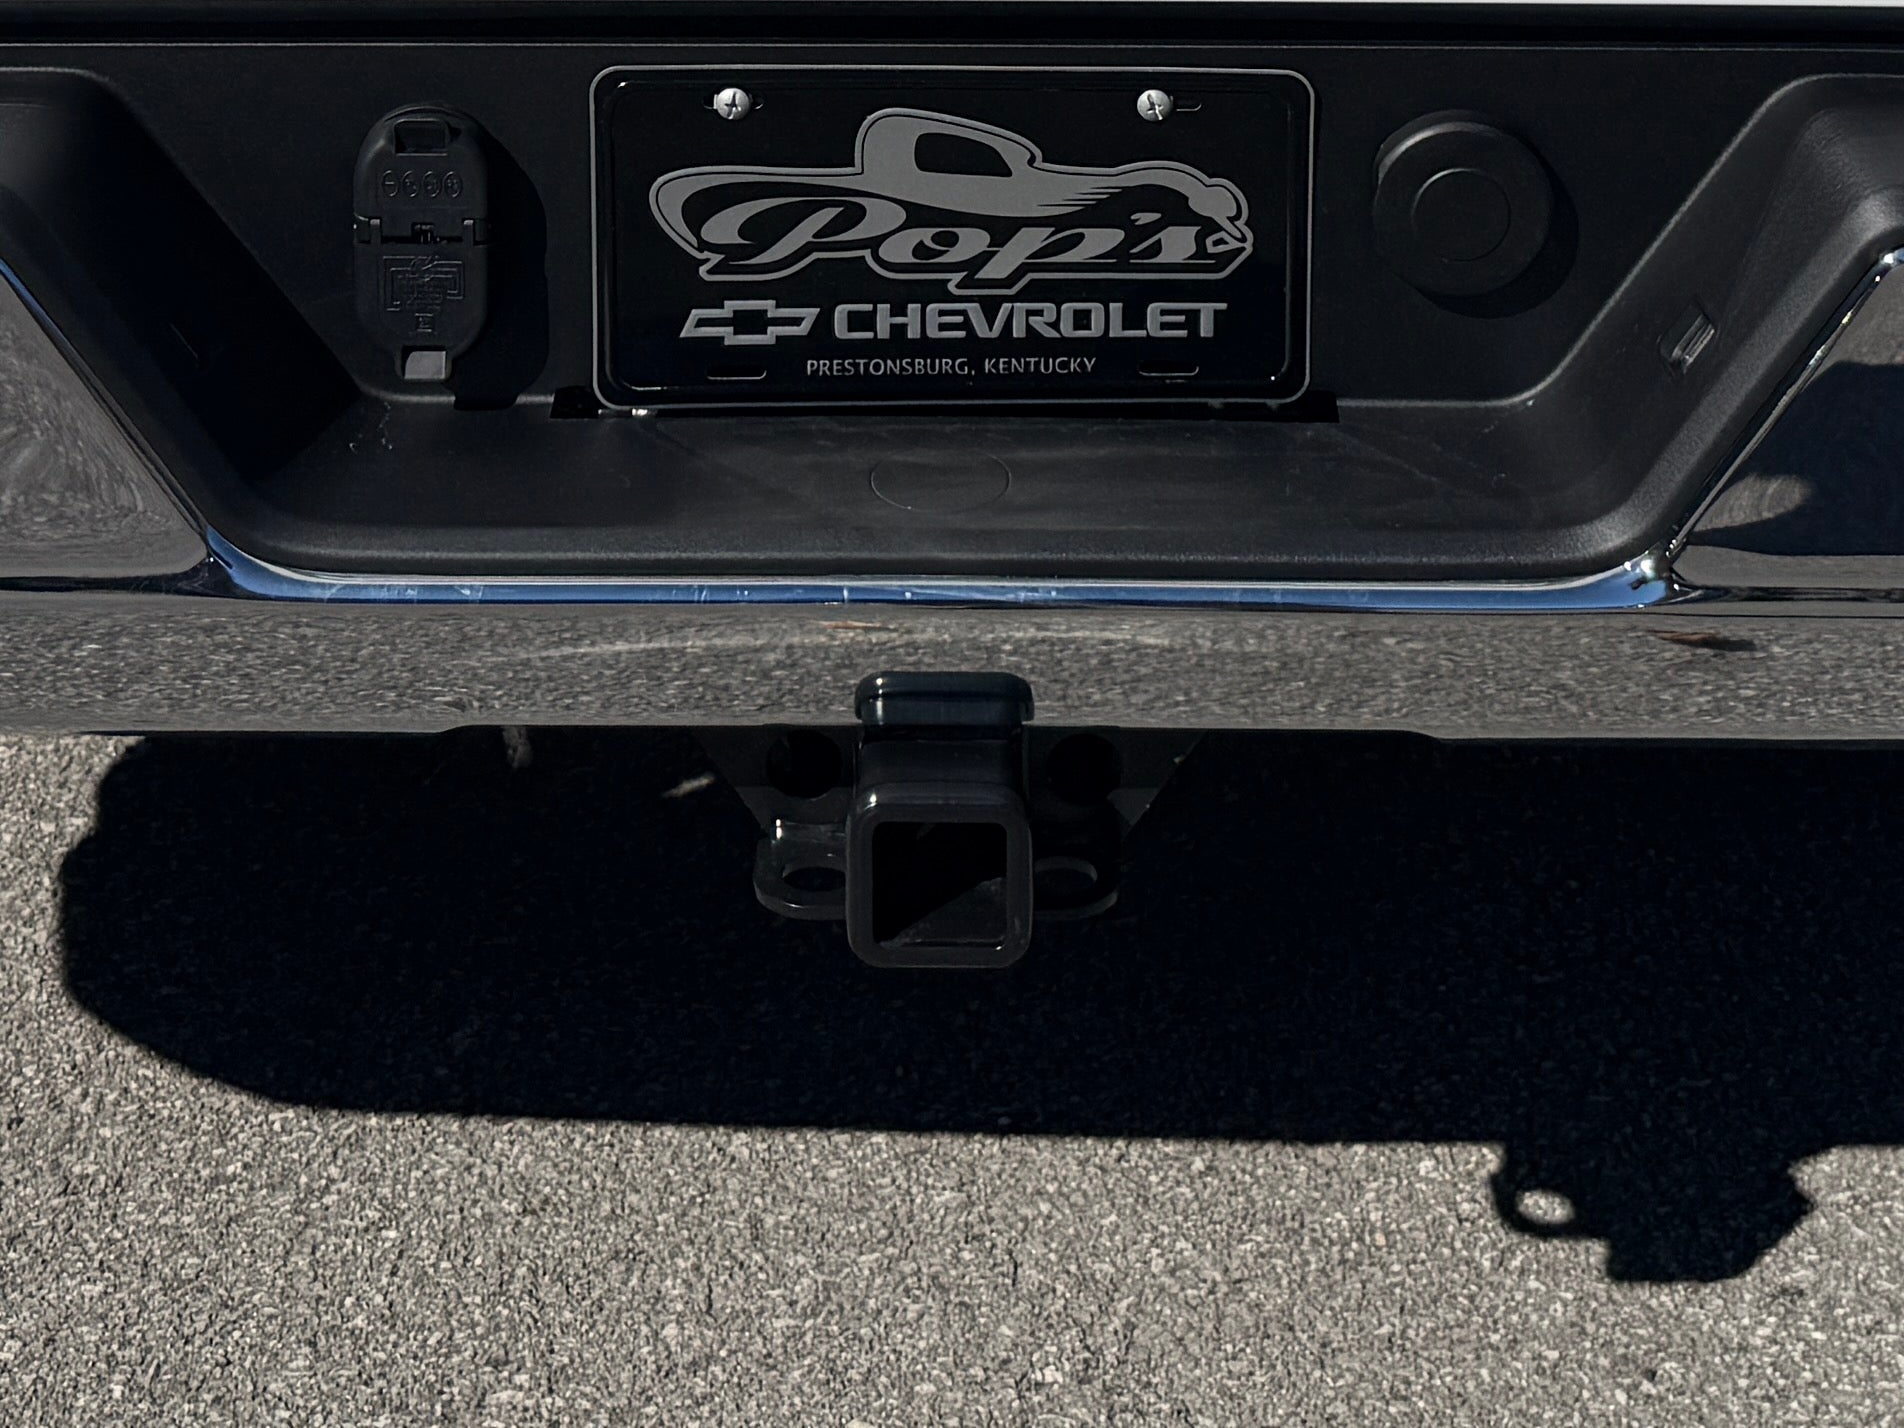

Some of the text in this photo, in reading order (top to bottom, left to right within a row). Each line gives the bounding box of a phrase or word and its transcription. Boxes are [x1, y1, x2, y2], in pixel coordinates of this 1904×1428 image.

[699, 195, 1218, 281] Pop's
[833, 301, 1229, 340] CHEVROLET
[805, 356, 1097, 378] PRESTONSBURG, KENTUCKY
